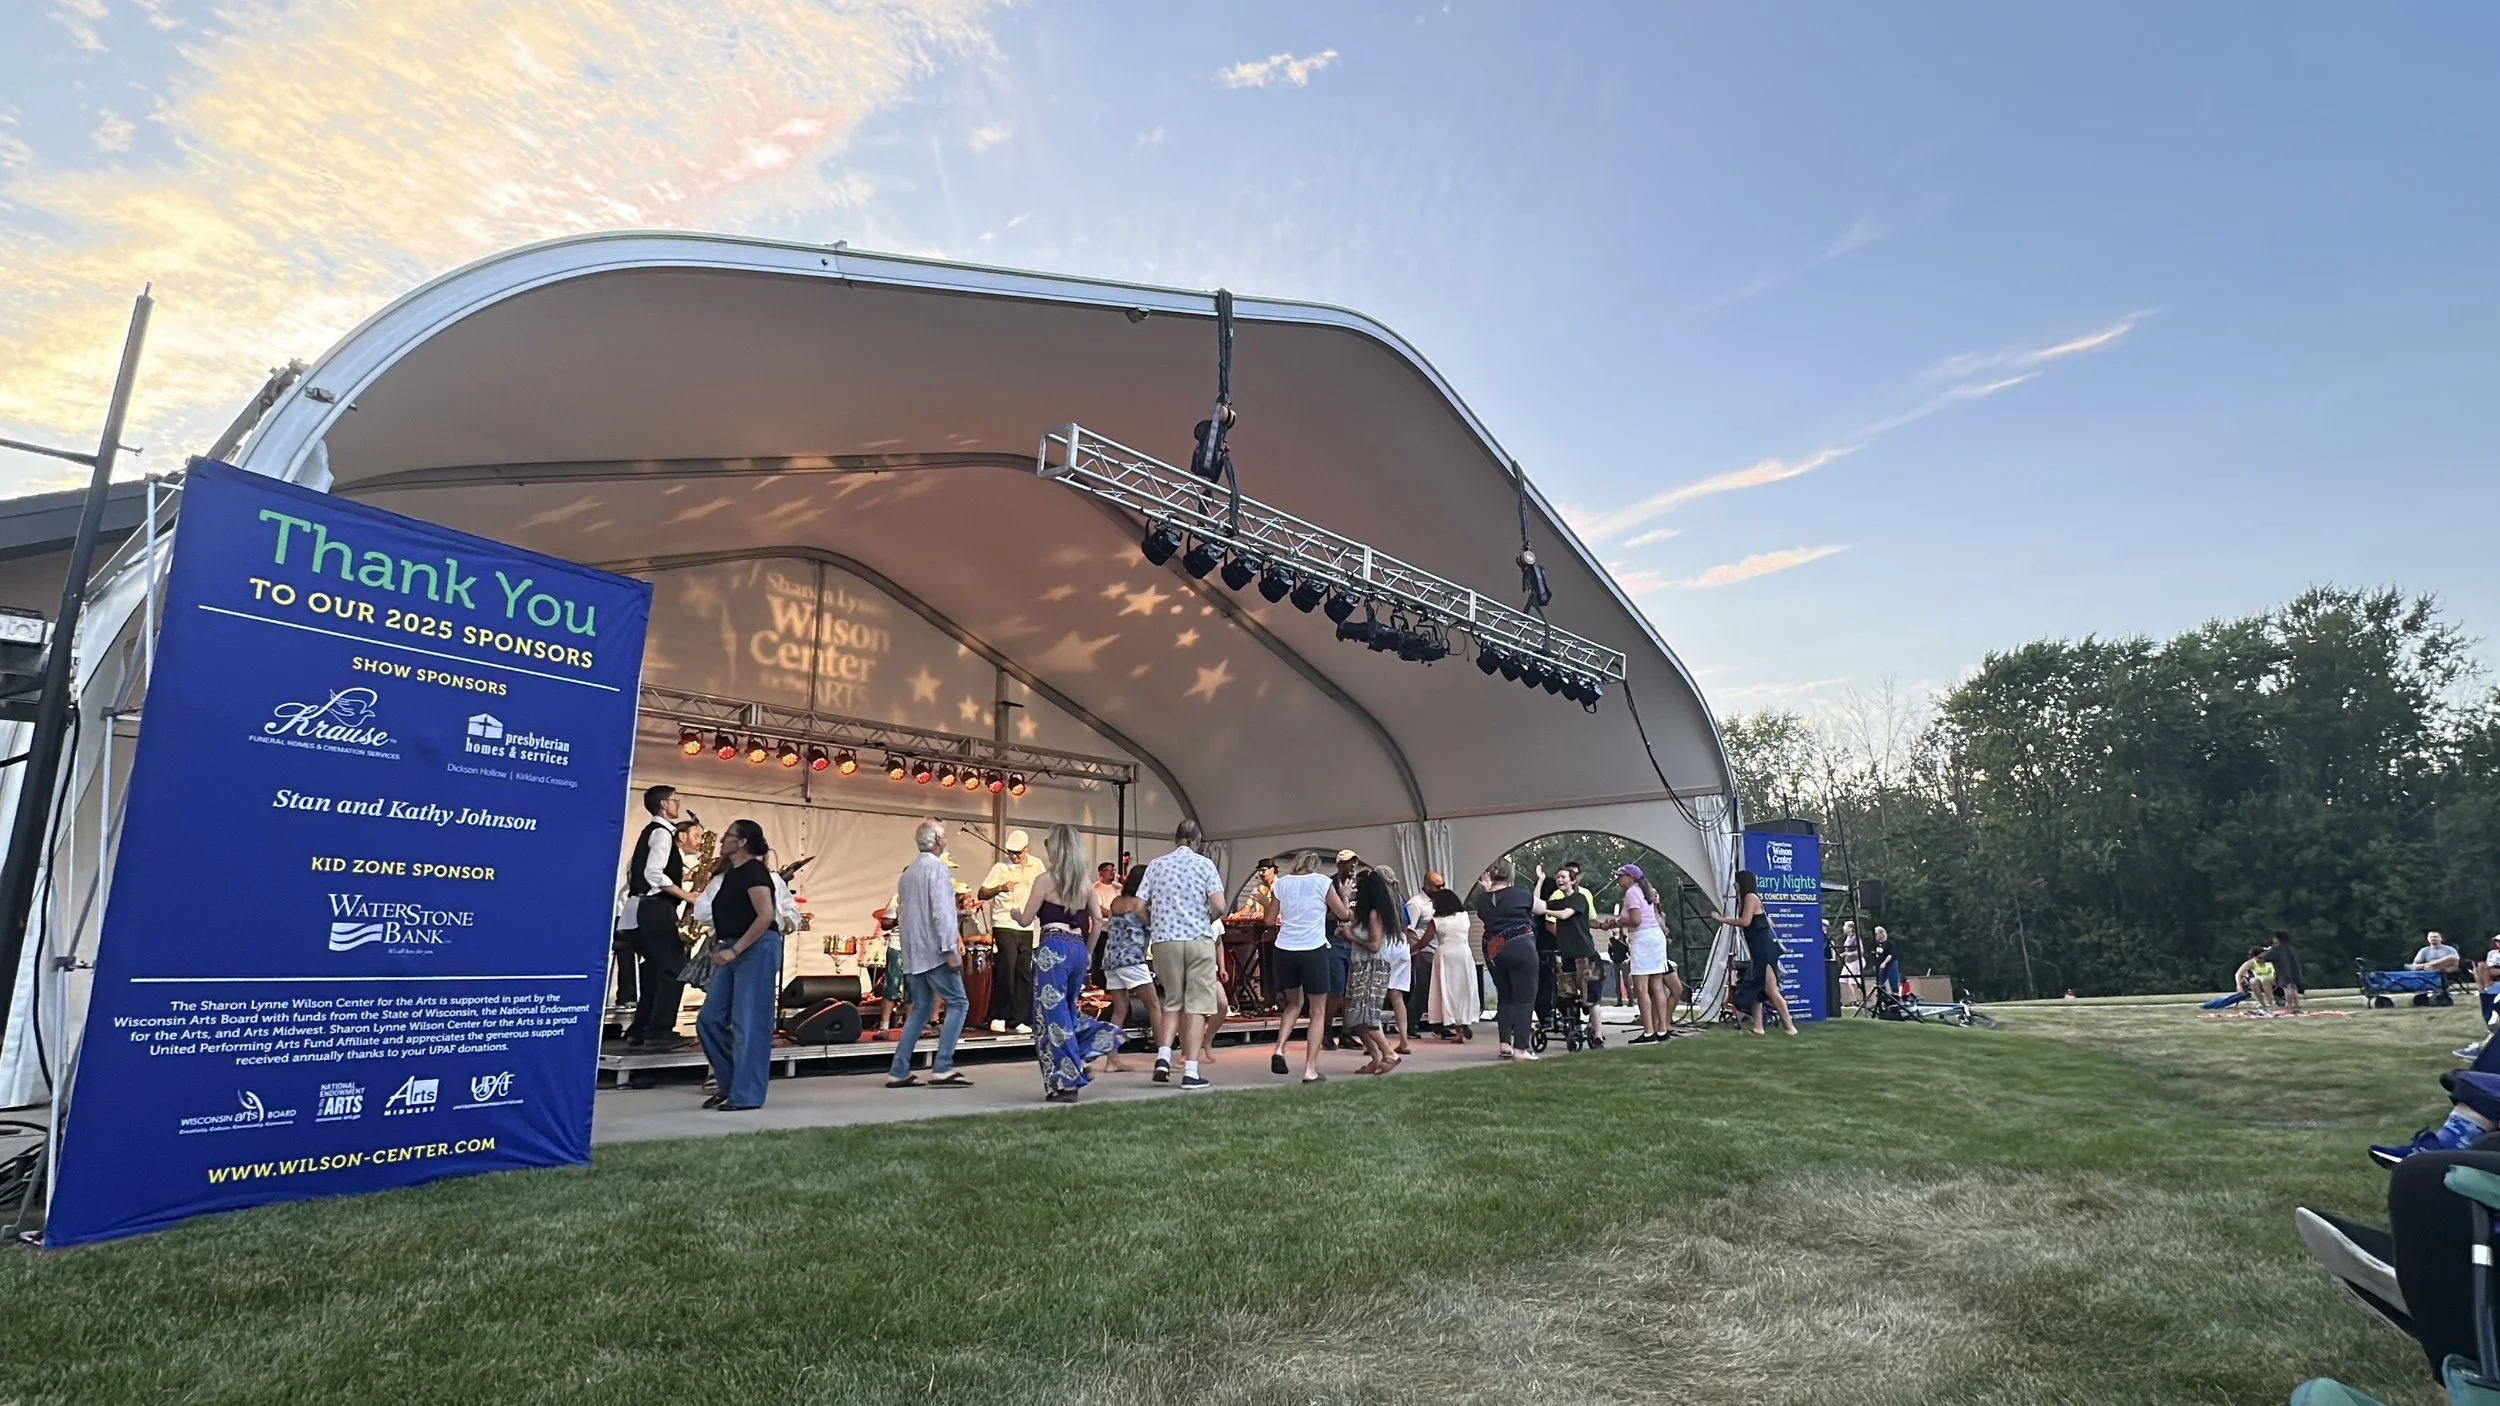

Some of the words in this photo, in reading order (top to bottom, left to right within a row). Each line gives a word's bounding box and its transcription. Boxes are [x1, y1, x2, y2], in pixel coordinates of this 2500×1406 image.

[259, 508, 478, 610] Thank
[495, 570, 596, 637] You
[249, 577, 296, 606] TO
[308, 592, 375, 623] OUR
[385, 609, 453, 640] 2025
[463, 625, 594, 669] SPONSORS
[352, 656, 412, 678] SHOW
[416, 669, 507, 696] SPONSORS
[264, 687, 389, 747] Krause
[248, 734, 285, 746] FUNERAL
[287, 739, 315, 750] HOMES
[323, 744, 365, 756] CREMATION
[366, 750, 400, 760] SERVICES
[465, 737, 505, 757] homes
[508, 746, 517, 758] &
[520, 750, 569, 766] services
[505, 732, 570, 752] presbyterian
[447, 763, 478, 775] Dickson
[480, 767, 507, 779] Hollow
[516, 772, 546, 783] Kirkland
[545, 775, 578, 788] Crossings
[272, 789, 331, 812] Stan
[336, 798, 385, 817] and
[387, 800, 454, 827] Kathy
[455, 807, 538, 831] Johnson
[311, 856, 347, 872] KID
[352, 859, 406, 875] ZONE
[412, 863, 495, 881] SPONSOR
[1755, 875, 1780, 891] tarry
[1783, 874, 1817, 892] Nights
[383, 921, 444, 944] BANK
[170, 1000, 197, 1011] The
[200, 999, 247, 1011] Sharon
[250, 999, 289, 1012] Lynne
[291, 998, 333, 1009] Wilson
[336, 998, 373, 1007] Center
[377, 997, 394, 1007] for
[396, 997, 414, 1006] the
[415, 996, 437, 1006] Arts
[439, 996, 448, 1005] is
[449, 995, 500, 1007] supported
[502, 995, 512, 1003] in
[513, 995, 532, 1005] part
[533, 994, 545, 1004] by
[546, 993, 561, 1002] the
[113, 1016, 186, 1028] Wisconsin
[189, 1015, 217, 1026] Arts
[220, 1014, 258, 1025] Board
[261, 1013, 290, 1023] with
[292, 1012, 327, 1022] funds
[329, 1011, 357, 1022] from
[360, 1010, 379, 1020] the
[381, 1010, 409, 1020] State
[411, 1009, 423, 1018] of
[424, 1008, 479, 1018] Wisconsin,
[481, 1007, 498, 1016] the
[499, 1005, 539, 1016] National
[540, 1004, 590, 1015] Endowment
[130, 1031, 150, 1042] for
[154, 1030, 178, 1040] the
[181, 1029, 212, 1041] Arts,
[215, 1028, 241, 1038] and
[243, 1027, 270, 1037] Arts
[273, 1026, 326, 1037] Midwest.
[330, 1024, 370, 1034] Sharon
[373, 1022, 407, 1034] Lynne
[409, 1021, 445, 1031] Wilson
[447, 1019, 481, 1029] Center
[482, 1018, 497, 1028] for
[498, 1018, 514, 1027] the
[516, 1017, 535, 1026] Arts
[536, 1017, 544, 1026] is
[552, 1015, 578, 1026] proud
[150, 1044, 196, 1056] United
[200, 1040, 273, 1054] Performing
[275, 1039, 301, 1050] Arts
[303, 1038, 333, 1049] Fund
[336, 1036, 379, 1046] Affiliate
[382, 1034, 403, 1045] and
[406, 1032, 465, 1046] appreciates
[467, 1031, 484, 1041] the
[485, 1029, 529, 1042] generous
[531, 1027, 564, 1039] support
[235, 1053, 289, 1066] received
[292, 1051, 344, 1063] annually
[347, 1049, 384, 1059] thanks
[387, 1049, 399, 1058] to
[400, 1048, 426, 1059] your
[429, 1045, 457, 1055] UPAF
[458, 1042, 509, 1053] donations.
[320, 1081, 355, 1090] NATIONAL
[320, 1087, 365, 1097] ENDOWMENT
[385, 1075, 436, 1108] Arts
[470, 1071, 515, 1102] UPAF
[180, 1114, 233, 1126] WISCONSIN
[234, 1110, 258, 1123] arts
[267, 1109, 297, 1119] BOARD
[323, 1095, 364, 1116] ARTS
[384, 1106, 436, 1116] MIDWEST
[208, 1137, 495, 1184] WWW.WILSON-CENTER.COM
